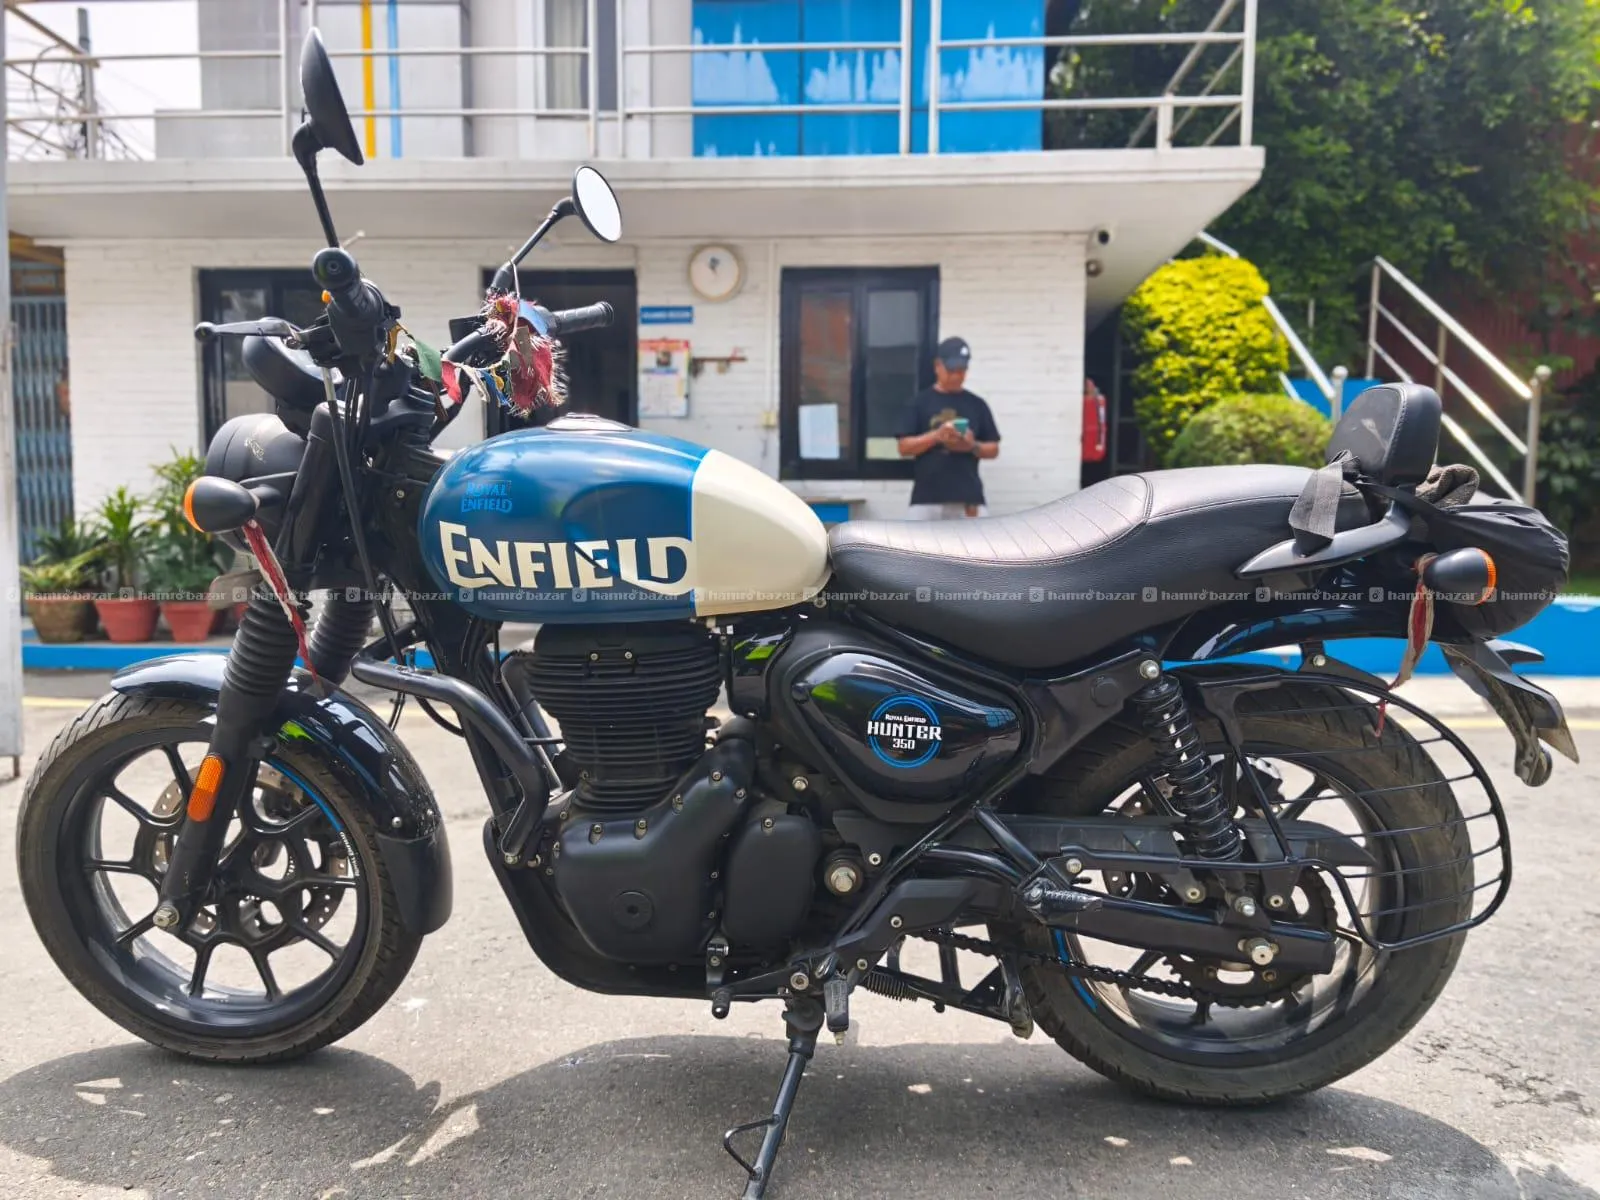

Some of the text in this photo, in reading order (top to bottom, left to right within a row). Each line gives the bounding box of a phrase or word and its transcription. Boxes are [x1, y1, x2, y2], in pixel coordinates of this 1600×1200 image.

[465, 482, 508, 497] ROYAL
[461, 497, 512, 513] ENFIELD
[439, 520, 692, 596] ENFIELD
[867, 720, 942, 740] HUNTER
[892, 738, 916, 750] 350
